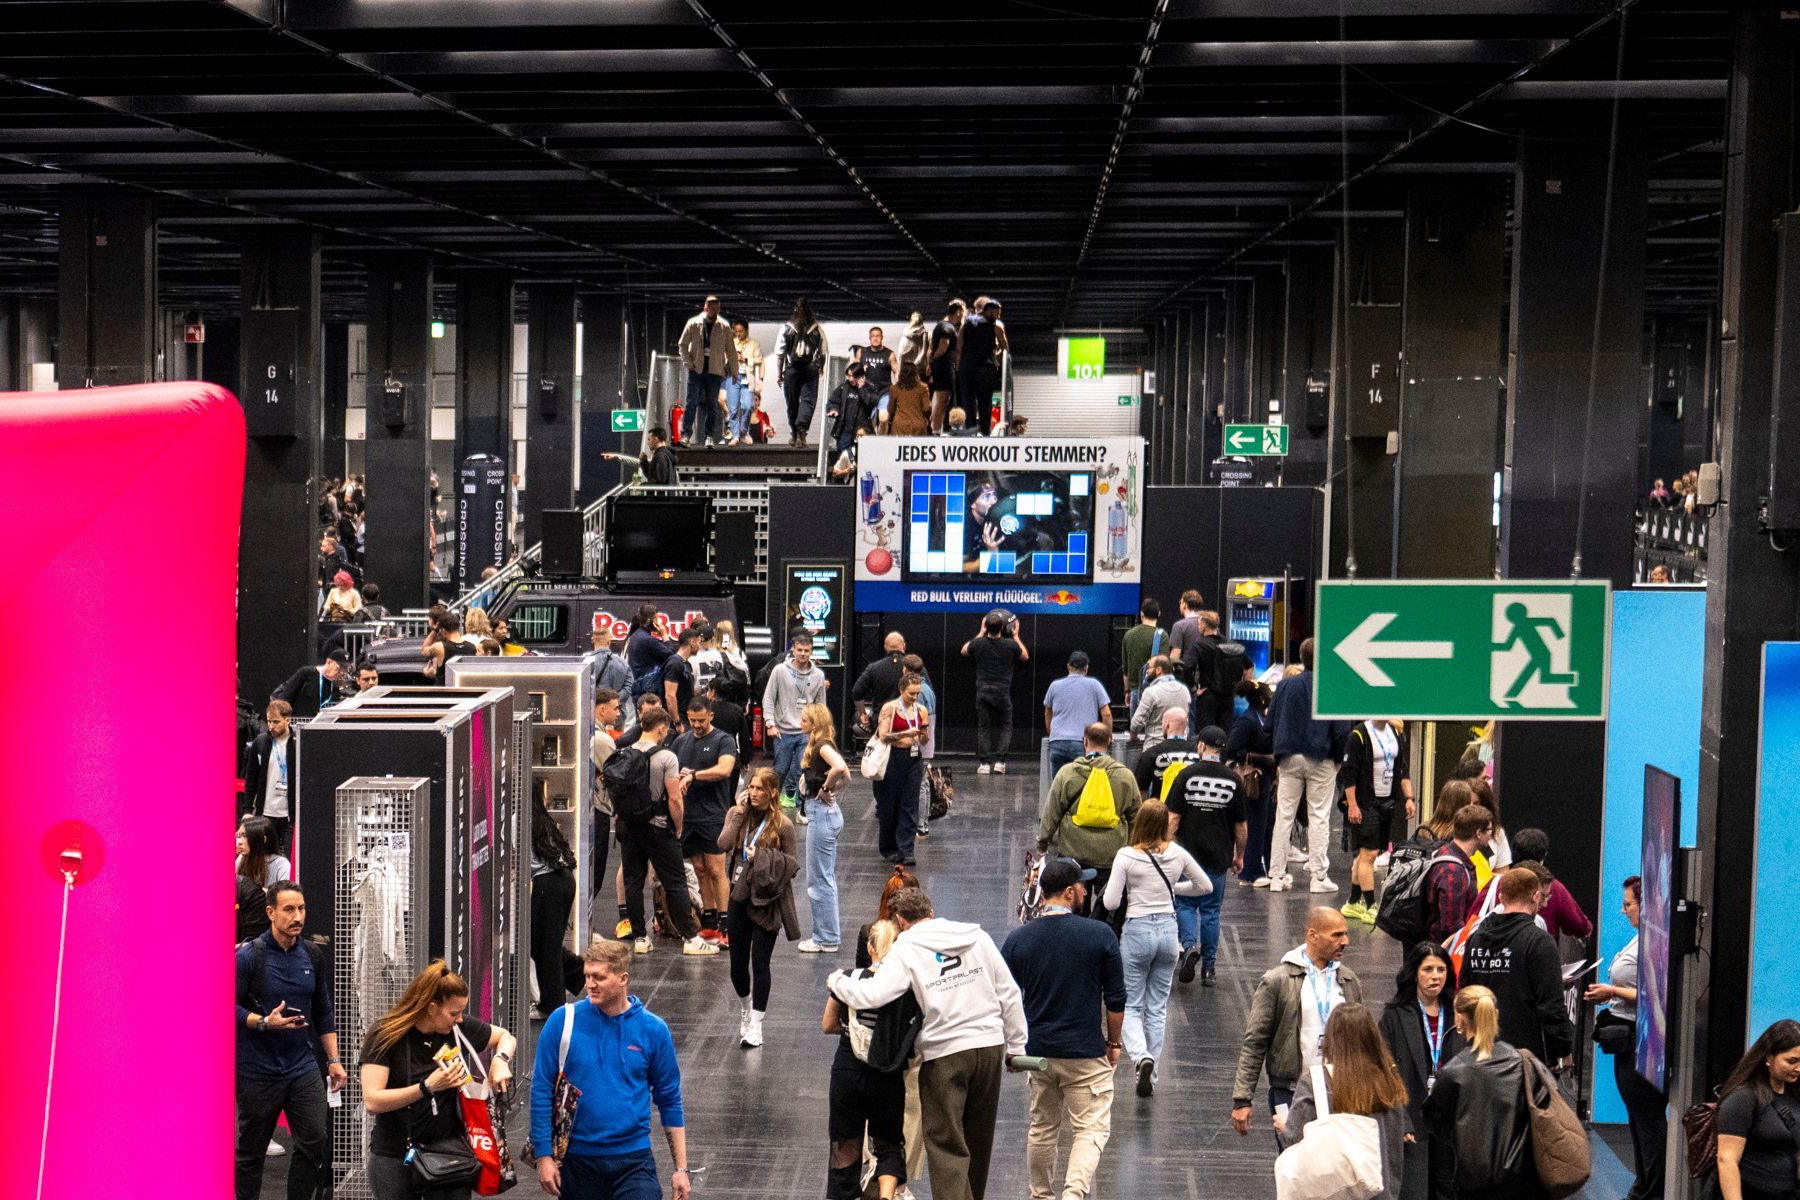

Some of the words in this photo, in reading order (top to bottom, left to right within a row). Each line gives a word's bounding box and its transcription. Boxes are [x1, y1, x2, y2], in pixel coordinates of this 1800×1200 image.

[267, 365, 277, 380] G
[1371, 363, 1381, 379] F
[265, 389, 279, 404] 14
[1368, 388, 1383, 404] 14
[895, 445, 937, 463] JEDES
[942, 445, 1019, 463] WORKOUT
[1024, 445, 1107, 463] STEMMEN?
[1220, 471, 1253, 479] CROSSING
[1220, 479, 1240, 487] POINT
[459, 499, 468, 577] CROSSING
[494, 500, 504, 567] CROSSIN
[910, 591, 928, 603] RED
[929, 591, 951, 603] BULL
[953, 591, 993, 603] VERLEIHT
[592, 611, 632, 641] Re
[651, 610, 703, 641] Bul
[1470, 958, 1511, 969] HYROX
[924, 966, 984, 990] SPORTPALAST
